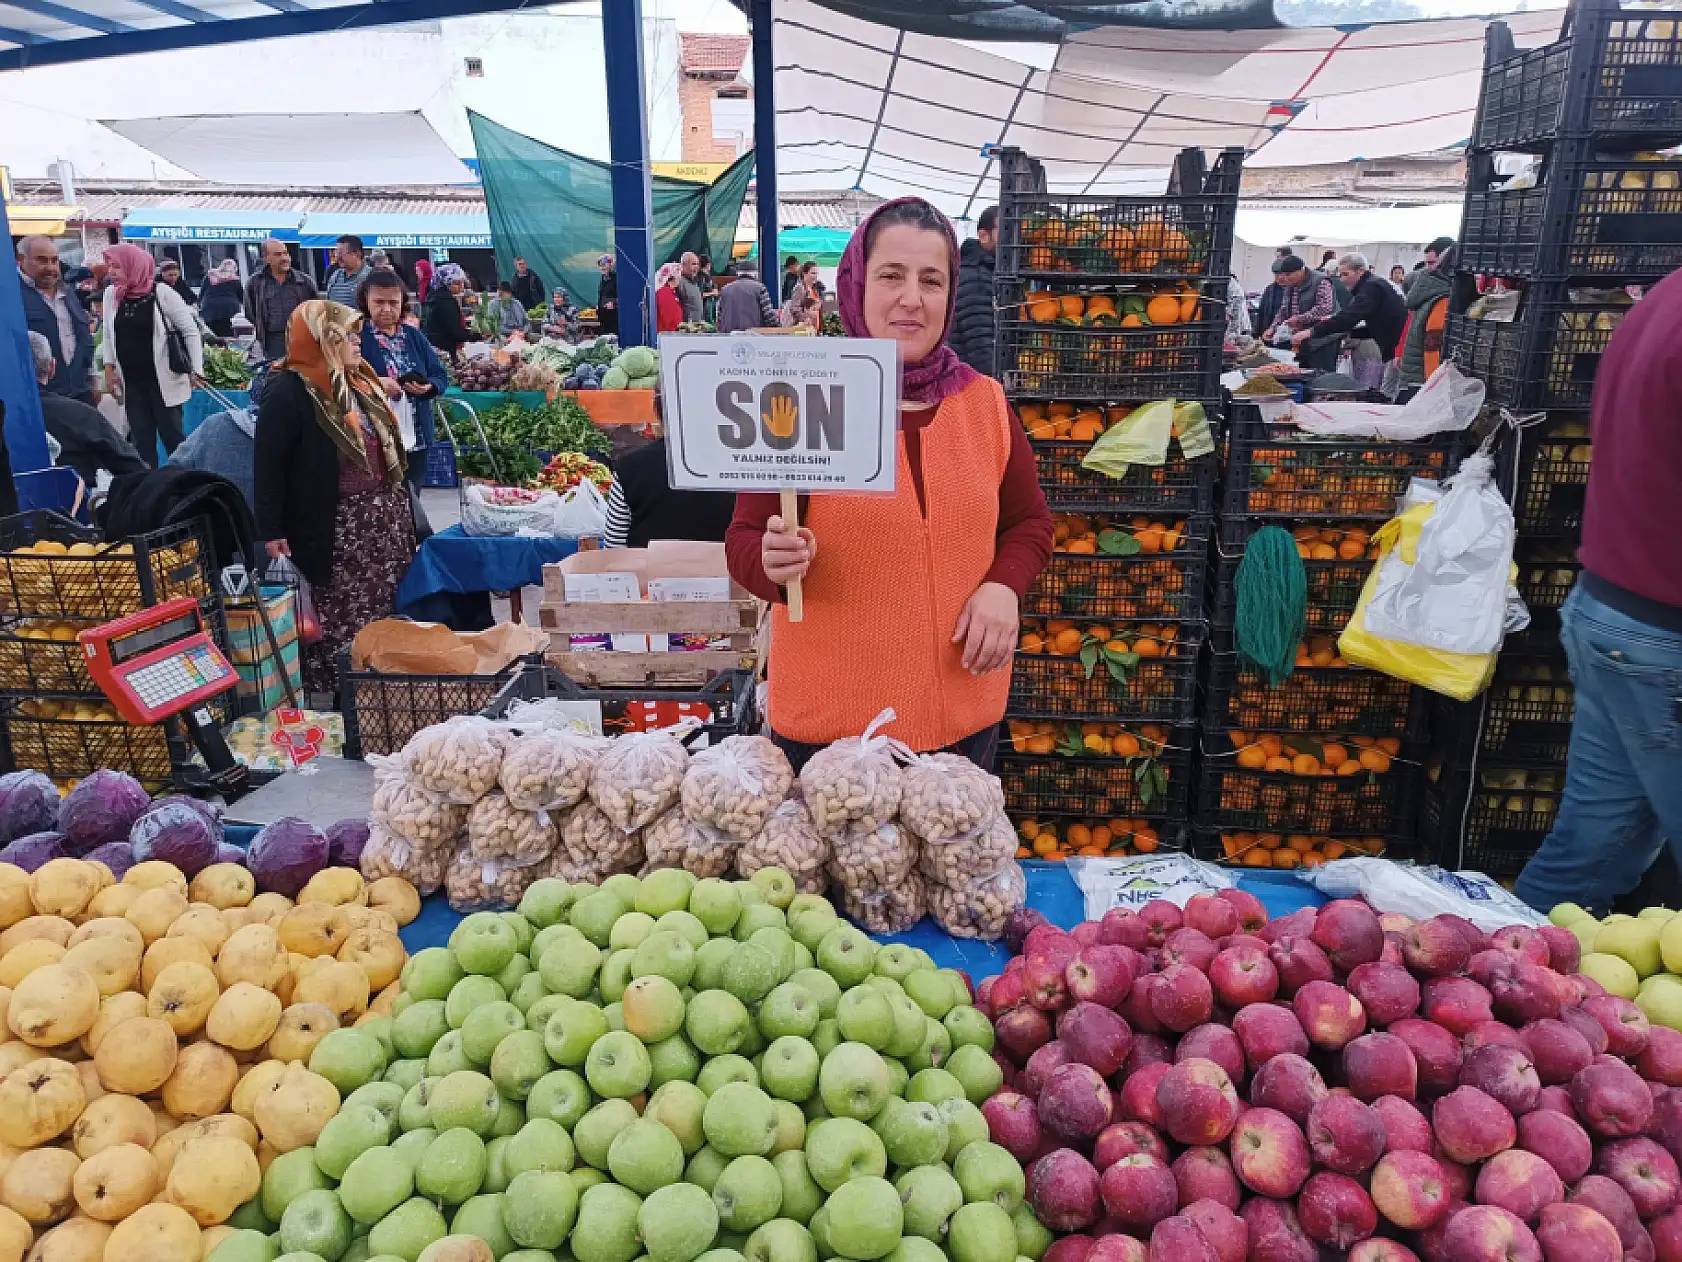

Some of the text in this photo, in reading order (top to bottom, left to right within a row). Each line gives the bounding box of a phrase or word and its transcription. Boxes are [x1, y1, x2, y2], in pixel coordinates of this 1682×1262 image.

[195, 228, 272, 240] RESTAURANT
[419, 235, 492, 246] RESTAURANT
[716, 381, 845, 451] SON
[732, 454, 831, 465] YALNIZ DEĞİLSİN!
